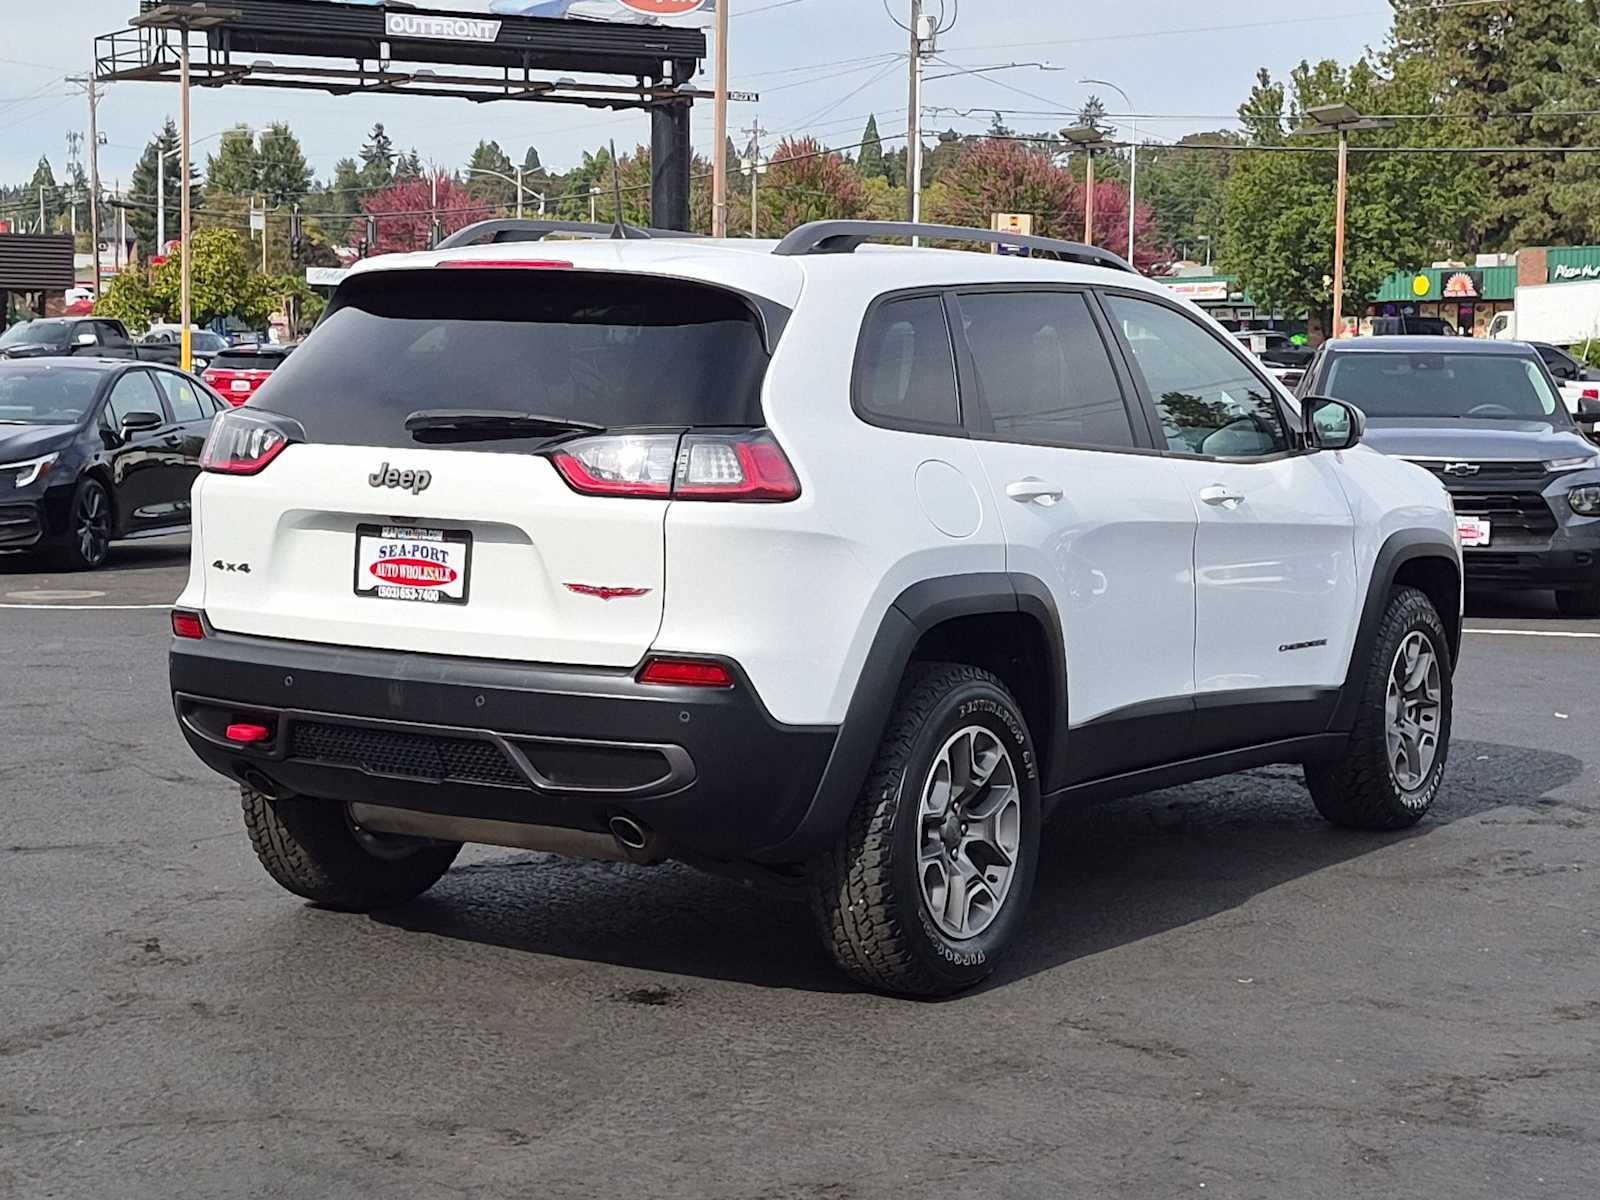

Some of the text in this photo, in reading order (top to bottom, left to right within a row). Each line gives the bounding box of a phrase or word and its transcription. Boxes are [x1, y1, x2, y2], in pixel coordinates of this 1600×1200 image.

[390, 16, 494, 39] OUTFRONT
[1554, 264, 1581, 279] Pizza
[369, 463, 432, 495] Jeep
[375, 563, 450, 582] AUTO WHOLESALE
